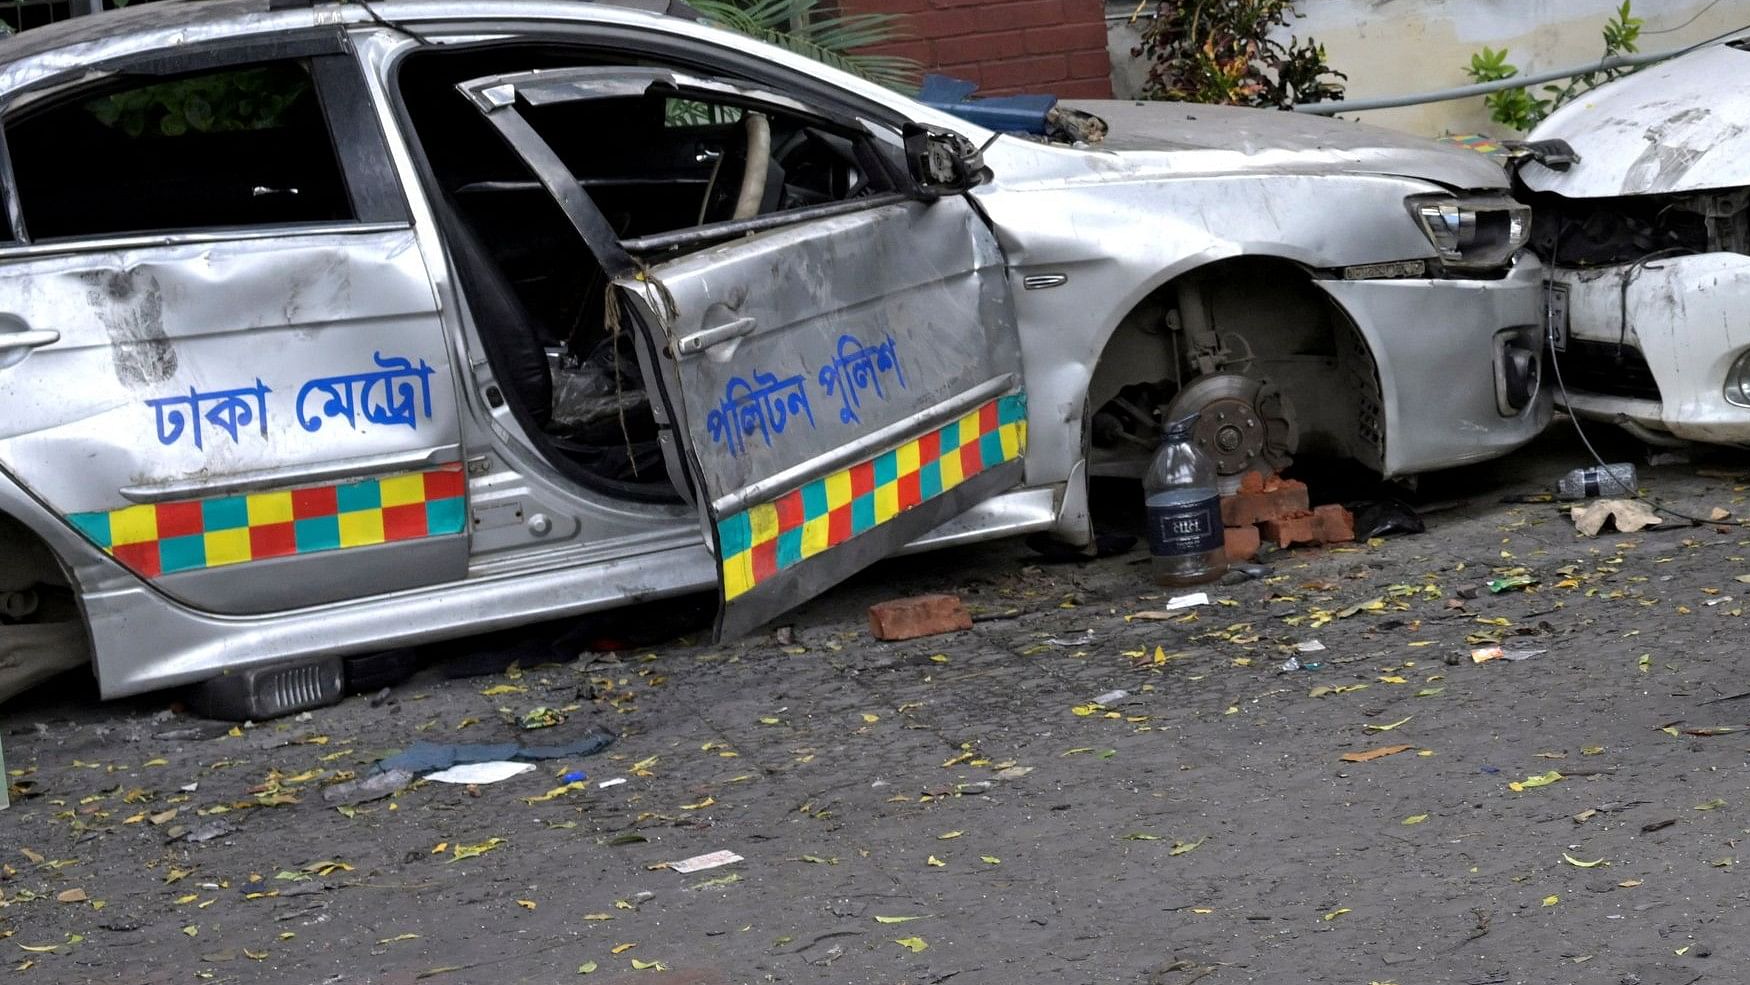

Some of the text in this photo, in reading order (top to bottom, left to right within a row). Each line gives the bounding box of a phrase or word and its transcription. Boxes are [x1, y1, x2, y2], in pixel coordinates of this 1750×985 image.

[144, 351, 436, 451] ঢাকা মেট্রো
[706, 327, 906, 458] পলিটন পুলিশ
